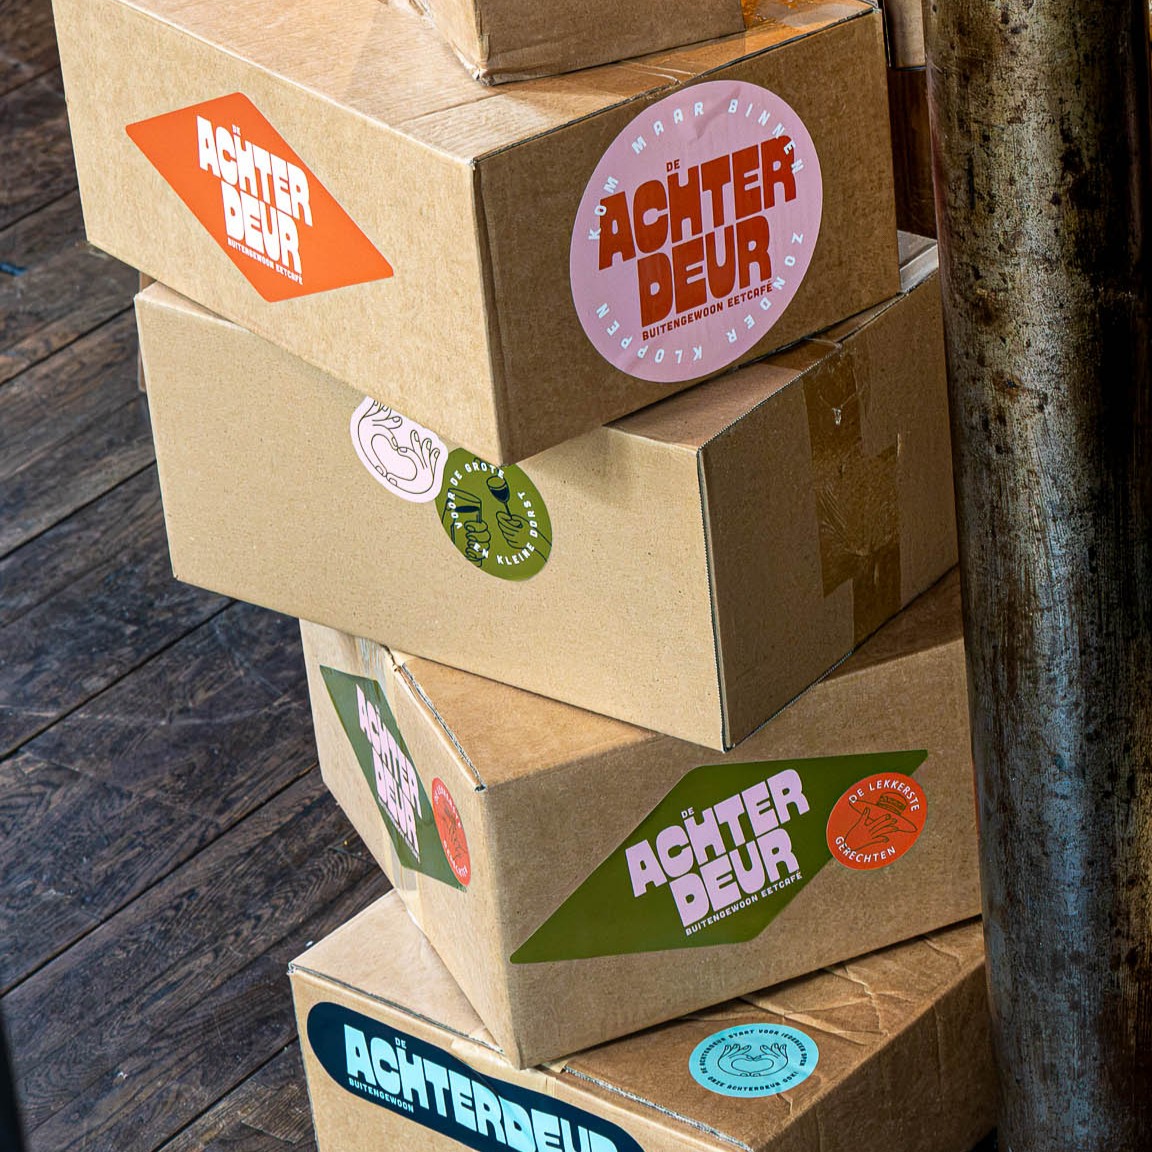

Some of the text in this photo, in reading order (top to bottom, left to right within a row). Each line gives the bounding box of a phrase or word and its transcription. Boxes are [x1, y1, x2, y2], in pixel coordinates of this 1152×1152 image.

[232, 124, 241, 136] DE
[197, 115, 313, 227] ACHTER
[588, 98, 804, 241] KOM MAAR BINNEN
[666, 159, 680, 172] DE
[220, 180, 302, 274] DEUR
[599, 134, 797, 270] ACHTER
[228, 237, 274, 269] BUITENGEWOON
[637, 215, 772, 327] DEUR
[596, 232, 804, 364] ZONDER KLOPPEN
[642, 280, 773, 341] BUITENGEWOON EETCAFÉ
[447, 462, 504, 529] VOOR DE GROTE
[474, 491, 538, 565] EN KLEINE DORST
[356, 684, 422, 819] ACHTER
[372, 747, 420, 854] DEUR
[681, 807, 694, 819] DE
[849, 779, 920, 811] DE LEKKERSTE
[625, 769, 810, 898] ACHTER
[835, 836, 896, 863] GERECHTEN
[669, 828, 800, 928] DEUR
[685, 871, 803, 936] BUITENGEWOON EETCAFÉ
[395, 1037, 406, 1049] DE
[348, 1077, 414, 1113] BUITENGEWOON
